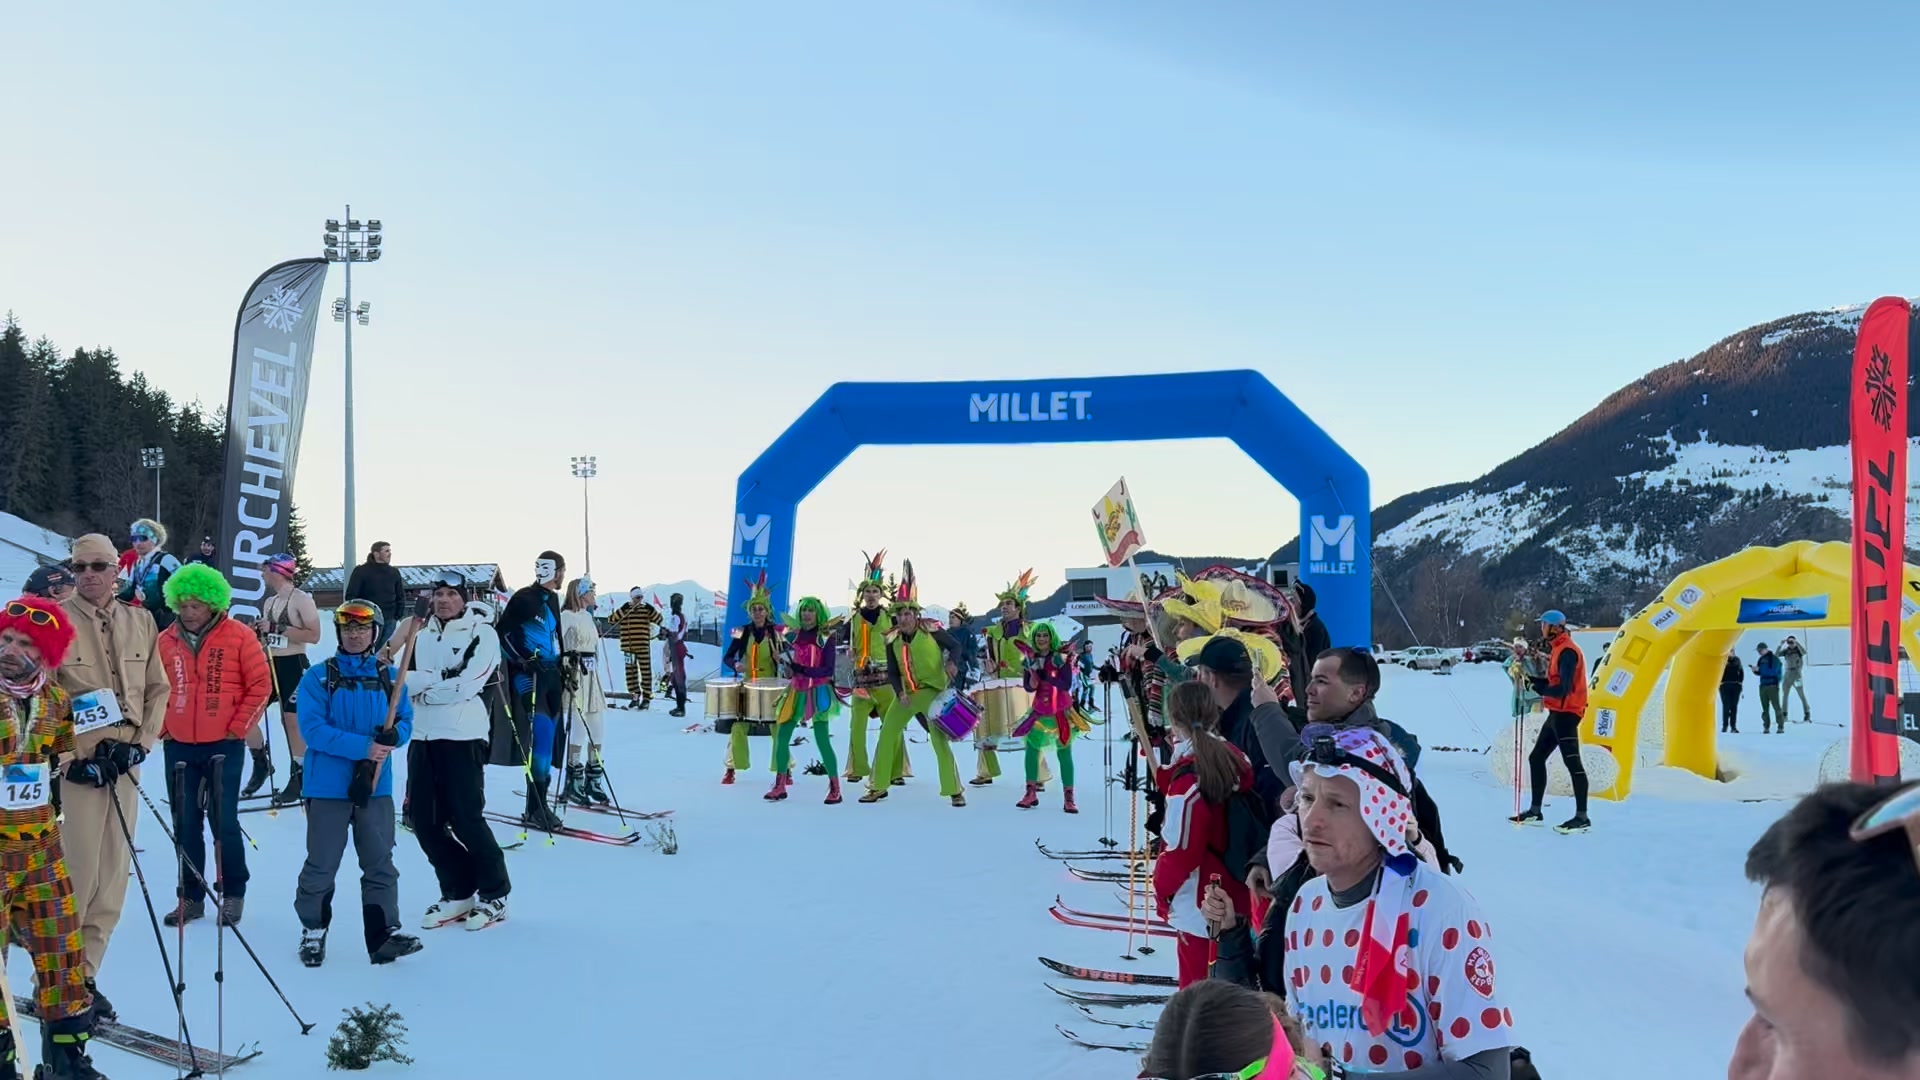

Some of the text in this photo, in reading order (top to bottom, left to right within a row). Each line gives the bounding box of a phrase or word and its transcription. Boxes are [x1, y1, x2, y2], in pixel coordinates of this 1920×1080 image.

[969, 391, 1093, 423] MILLET
[1310, 514, 1354, 561] M
[1309, 561, 1356, 574] MILLET
[75, 705, 109, 726] 453
[6, 783, 43, 802] 145
